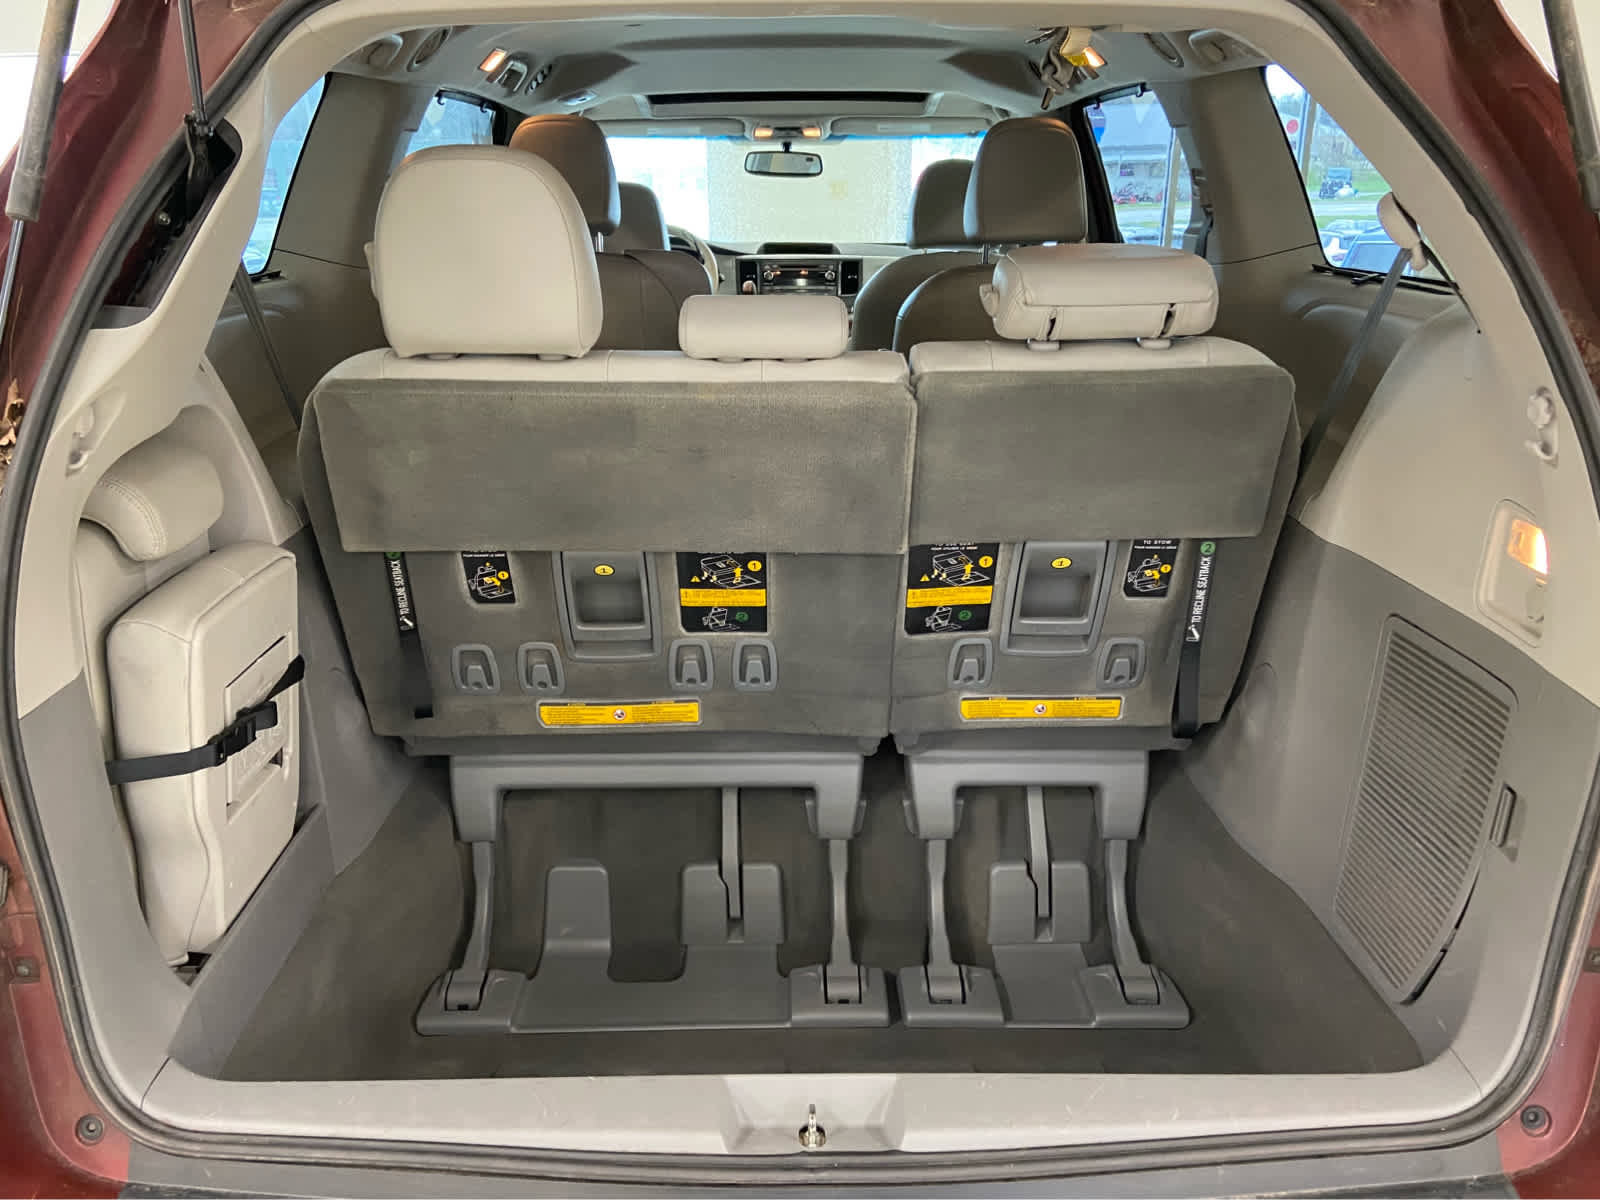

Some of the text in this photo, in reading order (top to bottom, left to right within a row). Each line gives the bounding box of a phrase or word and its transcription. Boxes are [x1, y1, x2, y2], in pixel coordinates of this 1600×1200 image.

[389, 560, 405, 587] SEATBACK
[395, 587, 409, 608] RECLINE
[1191, 557, 1213, 623] TO RECLINE SEATBACK
[399, 607, 410, 615] TO
